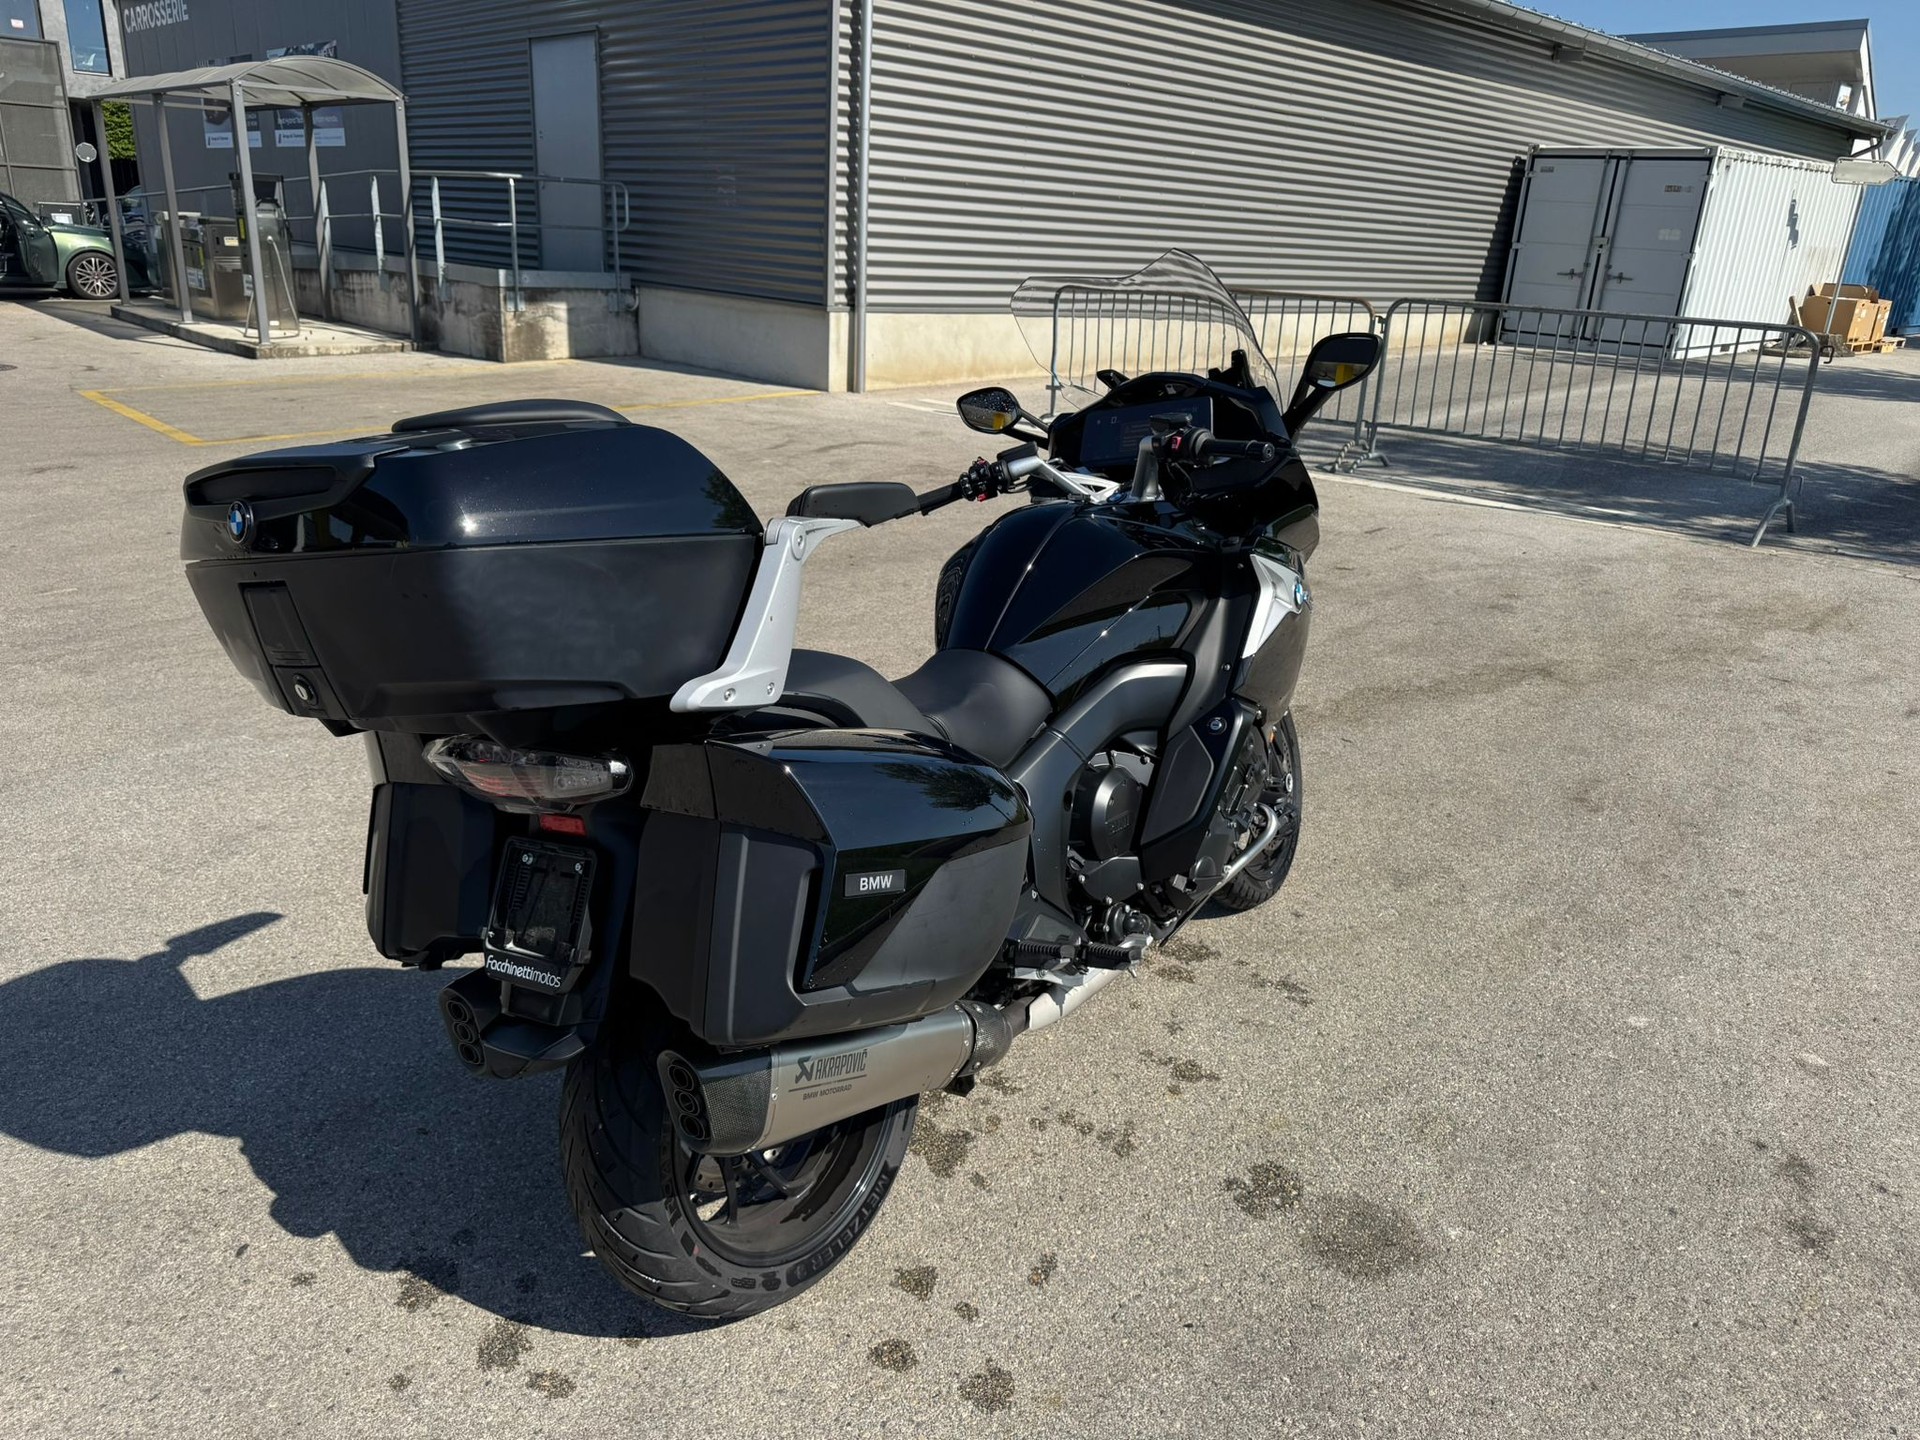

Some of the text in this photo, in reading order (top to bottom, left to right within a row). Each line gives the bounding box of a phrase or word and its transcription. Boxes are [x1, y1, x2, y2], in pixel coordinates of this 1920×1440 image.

[124, 0, 189, 33] CARROSSERIE
[860, 875, 893, 891] BMW
[820, 1084, 853, 1097] MOTORRAD
[811, 1174, 890, 1271] METZELER
